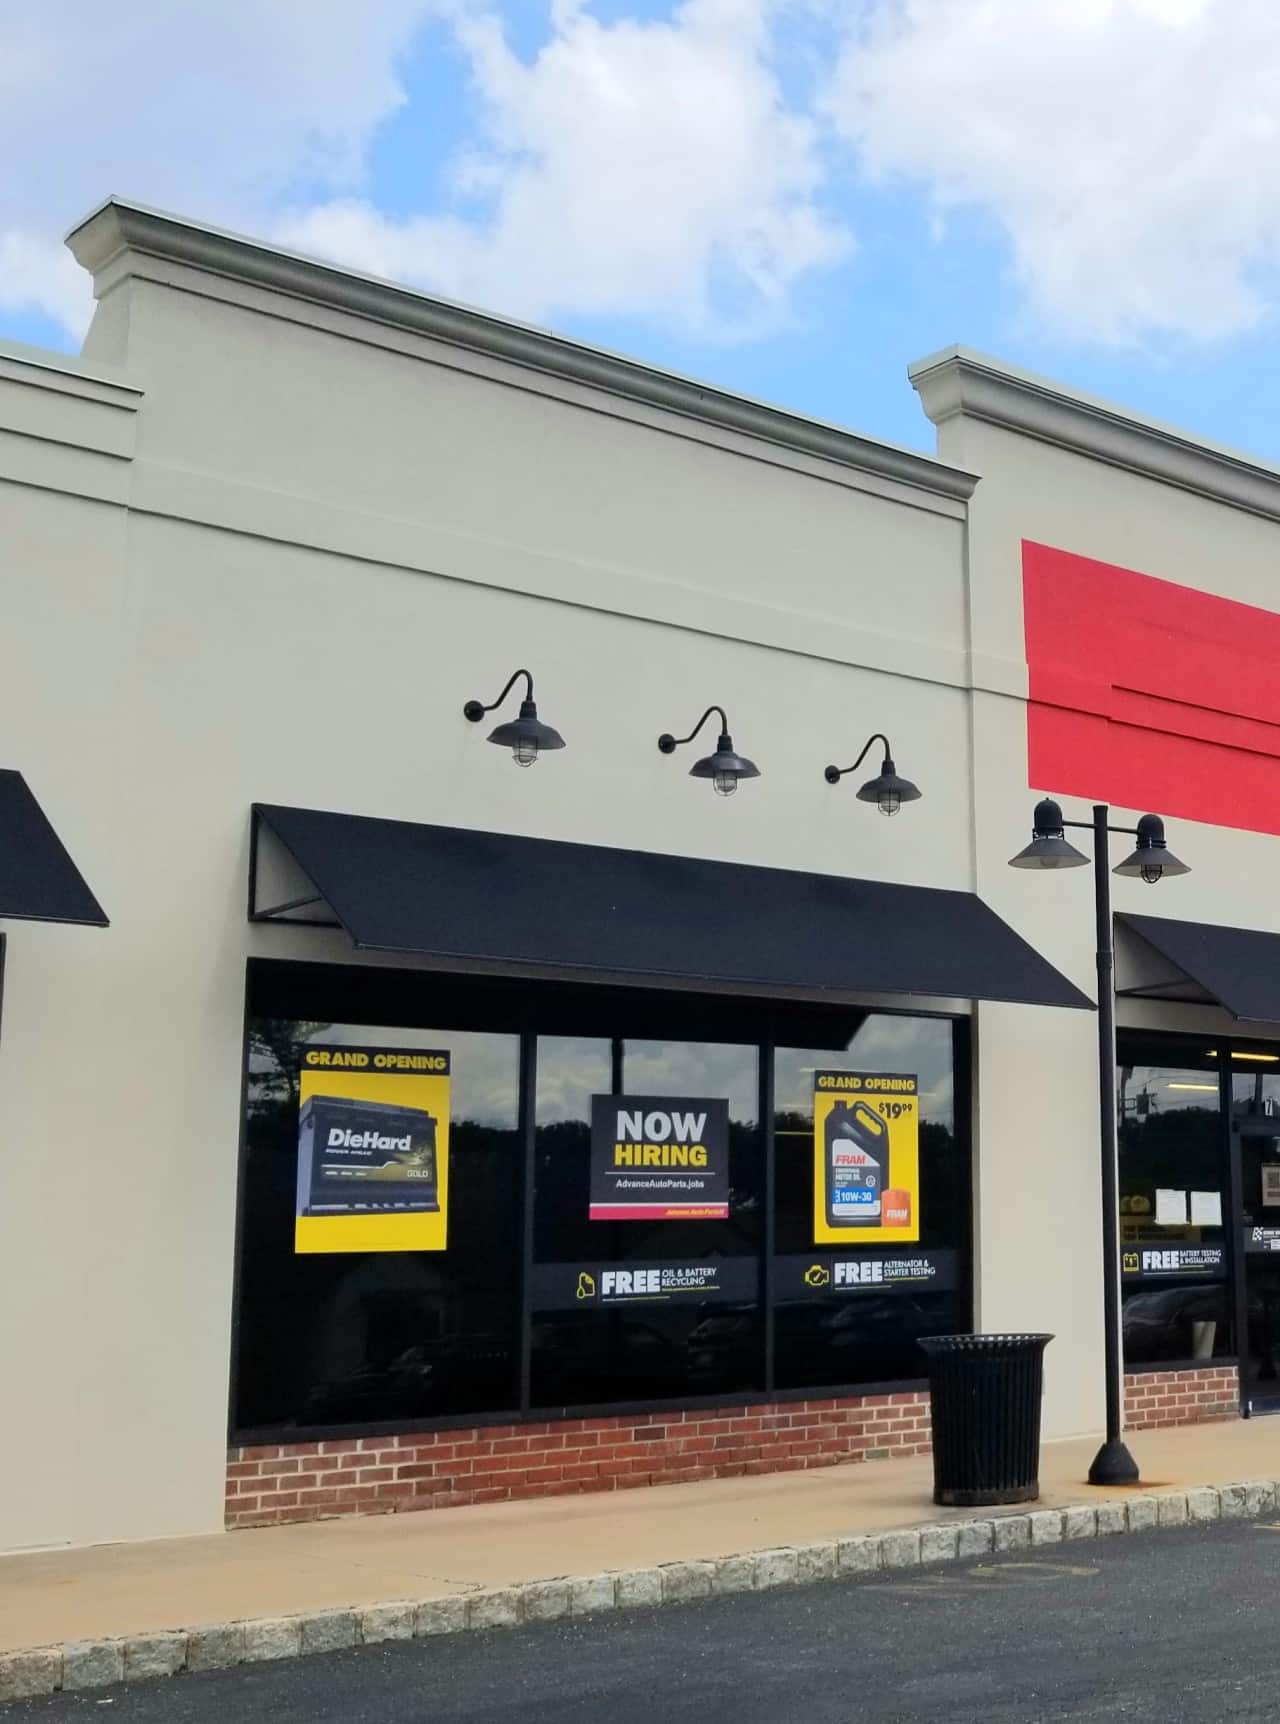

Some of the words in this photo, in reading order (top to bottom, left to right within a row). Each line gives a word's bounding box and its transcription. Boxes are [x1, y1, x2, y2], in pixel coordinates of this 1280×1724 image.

[305, 1050, 369, 1067] GRAND
[373, 1053, 447, 1071] OPENING
[818, 1075, 862, 1089] GRAND
[865, 1078, 916, 1091] OPENING
[616, 1110, 708, 1142] NOW
[327, 1128, 412, 1151] DieHard
[614, 1143, 708, 1167] HIRING
[834, 1154, 866, 1165] FRAM
[407, 1169, 429, 1179] GOLD
[615, 1179, 705, 1190] AdvanceAutoParts.jobs
[841, 1191, 872, 1202] 10W-30
[886, 1208, 908, 1219] FRAM
[1201, 1249, 1221, 1257] TESTING
[884, 1259, 923, 1269] ALTERNATOR
[924, 1259, 929, 1267] &
[1142, 1250, 1180, 1270] FREE
[662, 1269, 675, 1278] OIL
[677, 1268, 683, 1277] &
[685, 1267, 717, 1277] BATTERY
[834, 1261, 883, 1284] FREE
[884, 1268, 910, 1277] STARTER
[910, 1266, 936, 1276] TESTING
[602, 1269, 661, 1295] FREE
[662, 1277, 705, 1287] RECYCLING
